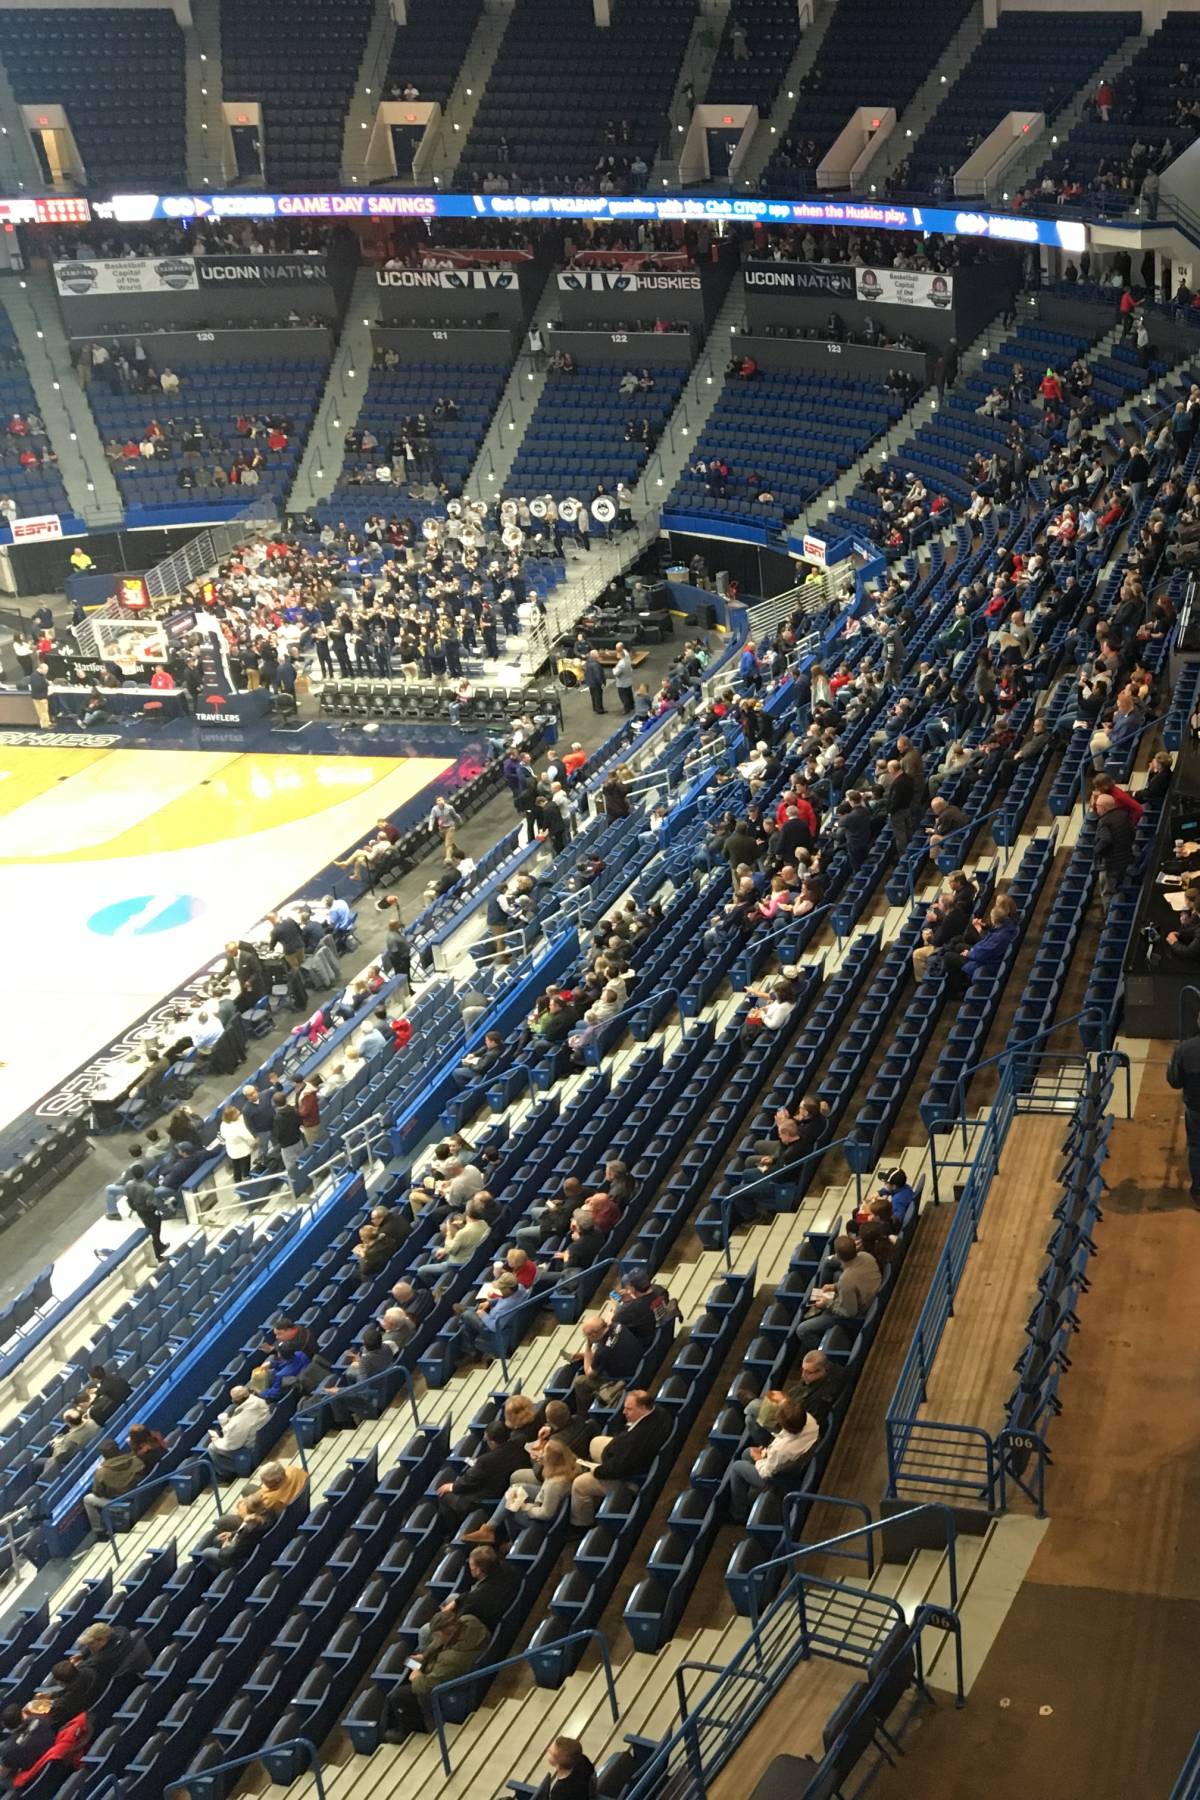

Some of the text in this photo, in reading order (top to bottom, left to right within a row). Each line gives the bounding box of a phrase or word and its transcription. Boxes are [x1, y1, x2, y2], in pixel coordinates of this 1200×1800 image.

[278, 197, 331, 213] GAME
[333, 197, 364, 213] DAY
[368, 197, 436, 213] SAVINGS
[793, 204, 823, 218] when
[824, 204, 844, 218] the
[845, 204, 884, 220] Huskies
[885, 208, 908, 225] play.
[104, 261, 146, 269] Basketball
[112, 269, 141, 278] Capital
[200, 266, 261, 280] UCONN
[376, 271, 441, 287] UCONN
[745, 271, 795, 287] UCONN
[637, 276, 701, 290] HUSKIES
[196, 332, 215, 341] 120
[432, 331, 448, 340] 121
[611, 335, 628, 343] 122
[827, 344, 841, 353] 123
[14, 520, 59, 537] ESPN
[804, 541, 825, 559] ESPN
[196, 712, 240, 723] TRAVELERS
[1008, 1436, 1033, 1449] 106
[930, 1614, 950, 1628] 06
